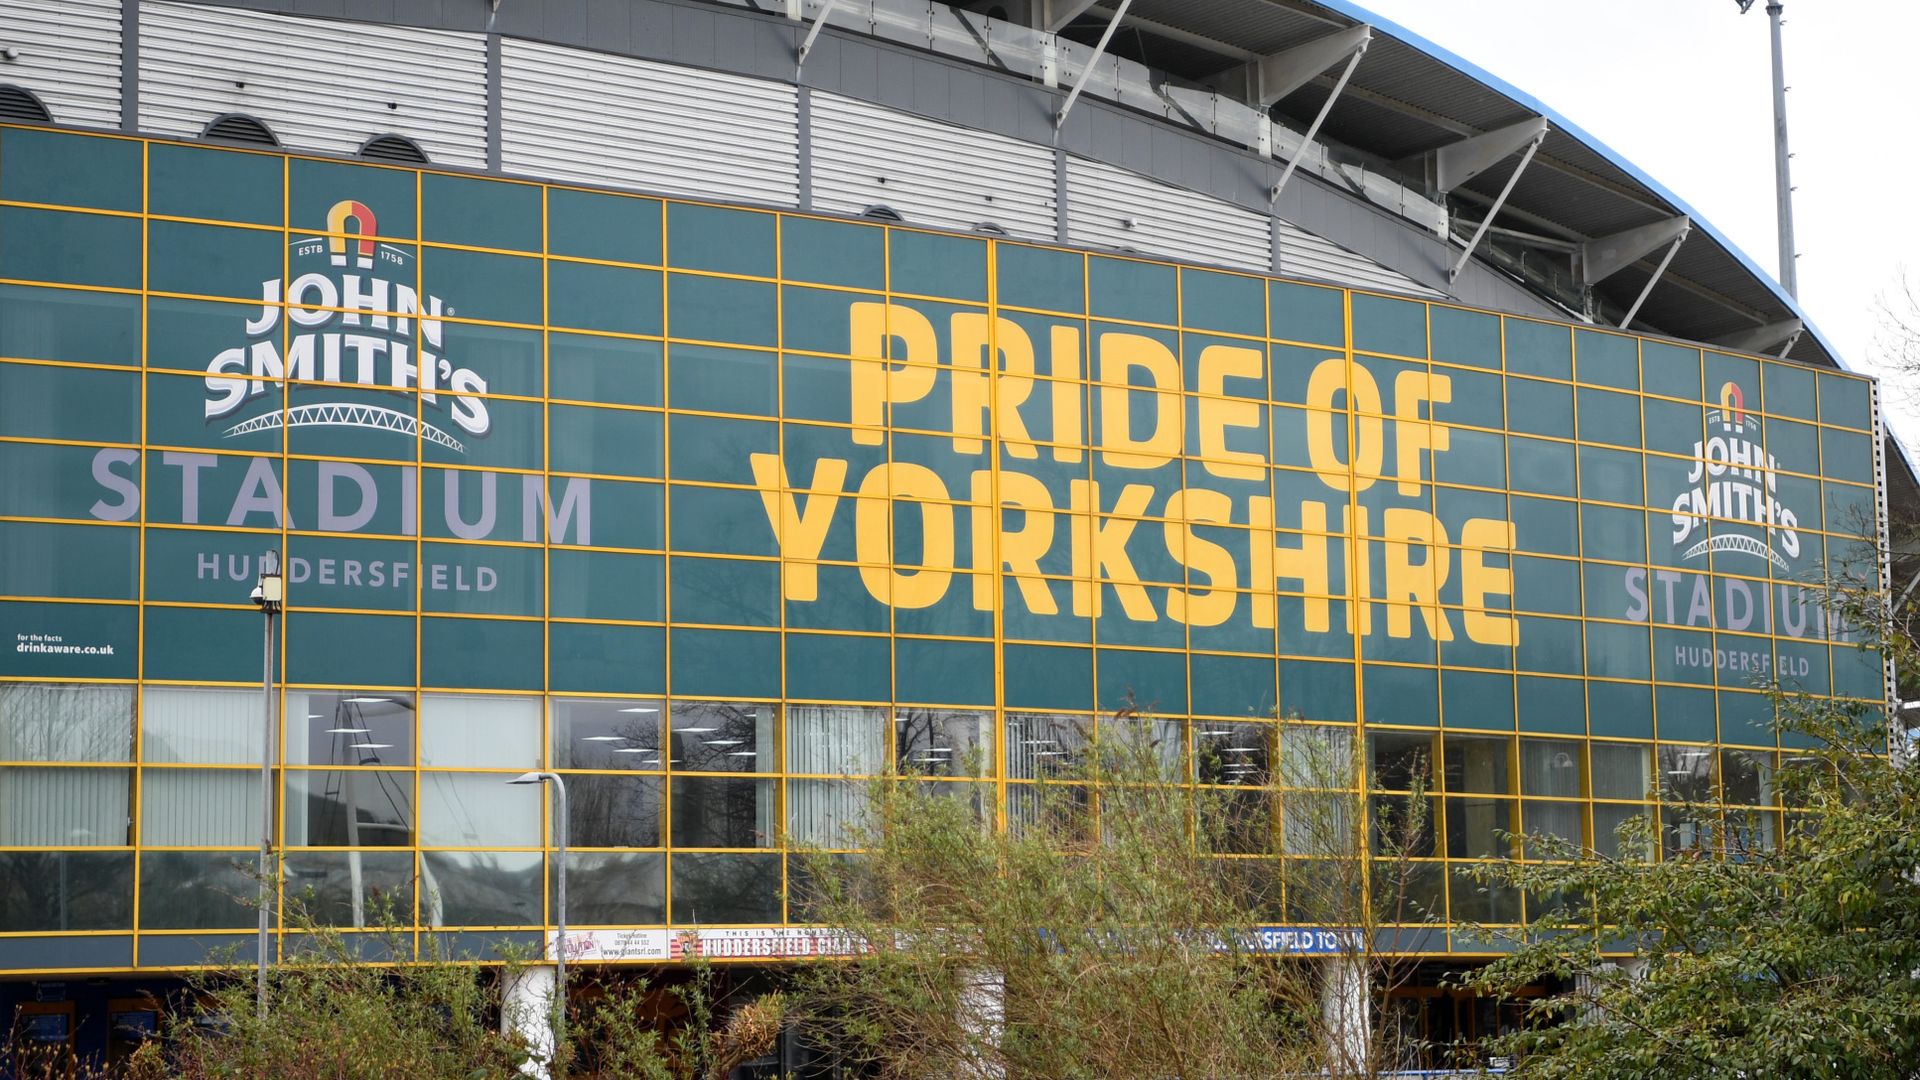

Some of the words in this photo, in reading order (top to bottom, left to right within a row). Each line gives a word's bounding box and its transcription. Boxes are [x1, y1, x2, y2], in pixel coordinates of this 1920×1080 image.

[298, 244, 323, 256] ESTB
[380, 251, 403, 265] 1758
[245, 273, 443, 348] JOHN
[205, 333, 491, 435] SMITH'S
[850, 302, 1266, 481] PRIDE
[1307, 359, 1451, 497] OF
[1688, 436, 1777, 493] JOHN
[89, 447, 592, 546] STADIUM
[1672, 481, 1800, 558] SMITH'S
[198, 552, 498, 592] HUDERSFELD
[750, 452, 1520, 646] YORKSHIRE
[16, 642, 114, 655] drinkaware.co.uk
[17, 633, 28, 641] for
[44, 634, 62, 642] facts
[1675, 645, 1810, 677] HUDDERSFELD
[702, 938, 810, 957] HUDDERSFIELD
